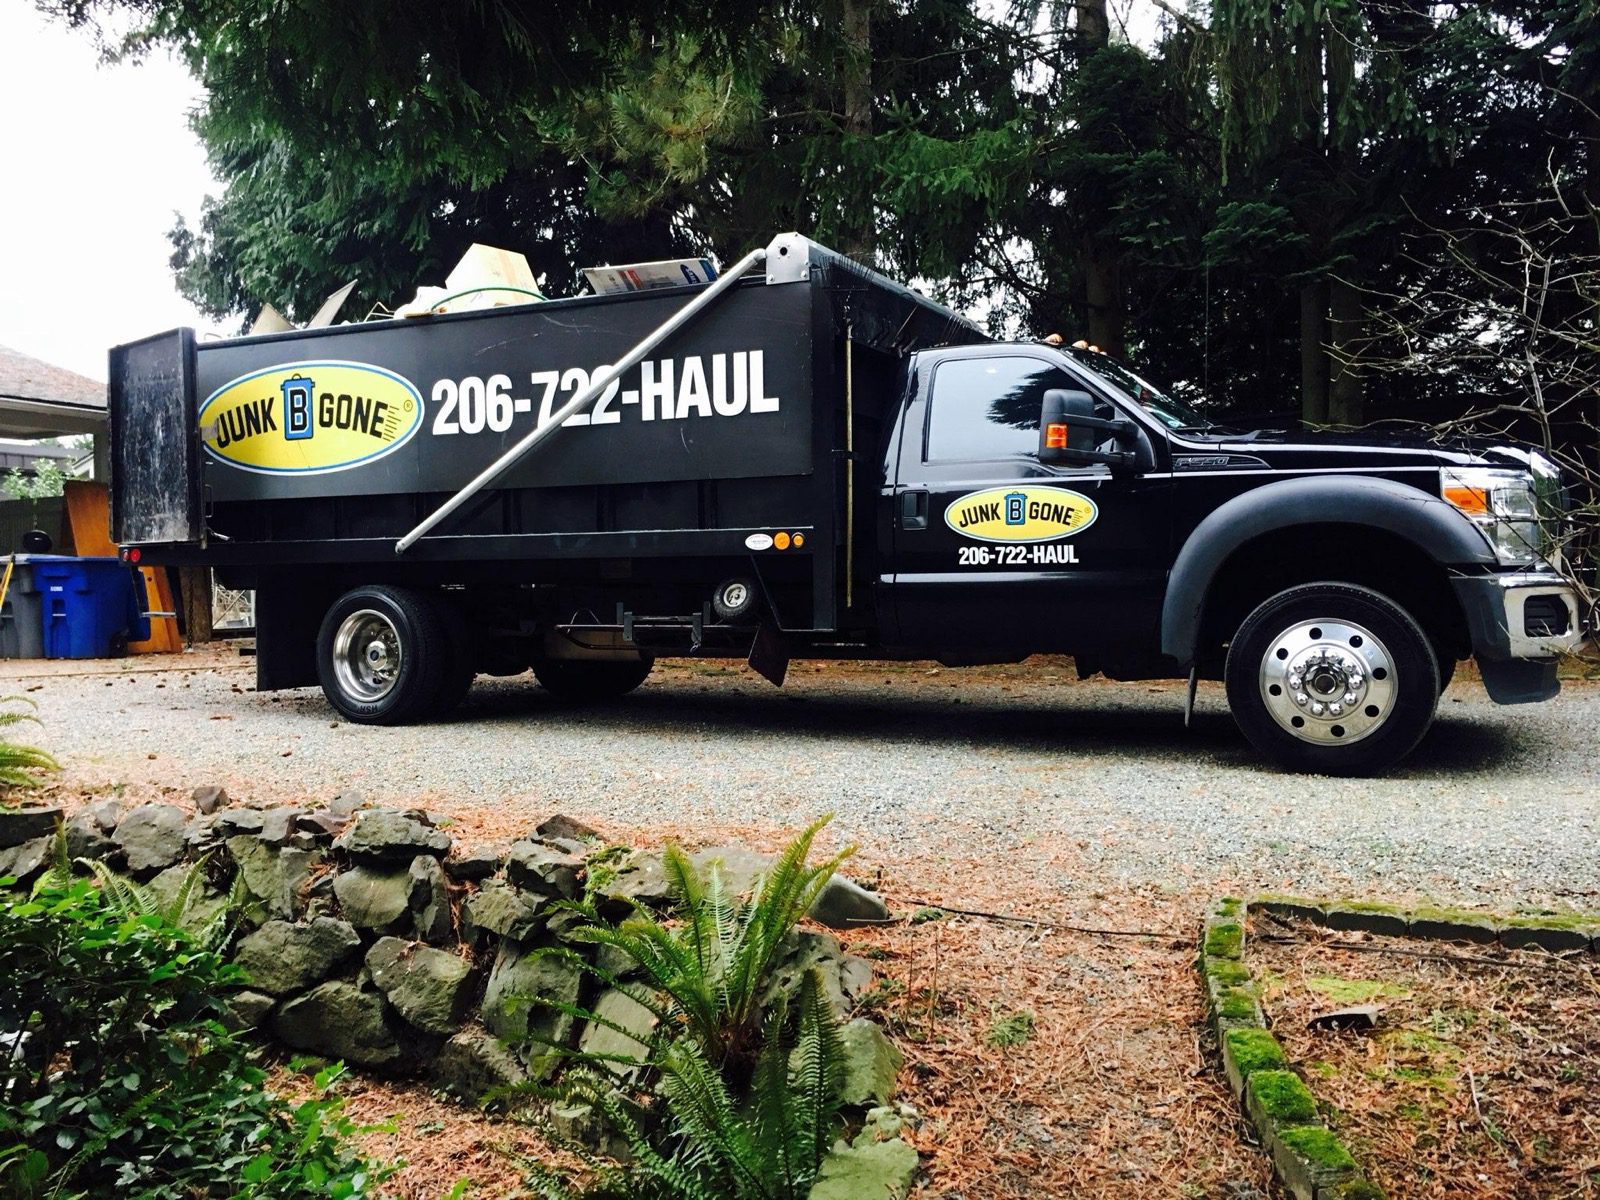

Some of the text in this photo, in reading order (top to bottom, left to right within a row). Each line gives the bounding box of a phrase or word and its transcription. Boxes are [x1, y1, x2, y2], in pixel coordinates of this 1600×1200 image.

[431, 350, 780, 436] 206-722-HAUL
[216, 387, 389, 449] JUNK B GONE
[959, 498, 1075, 528] JUNK B GONE
[958, 545, 1080, 565] 206-722-HAUL
